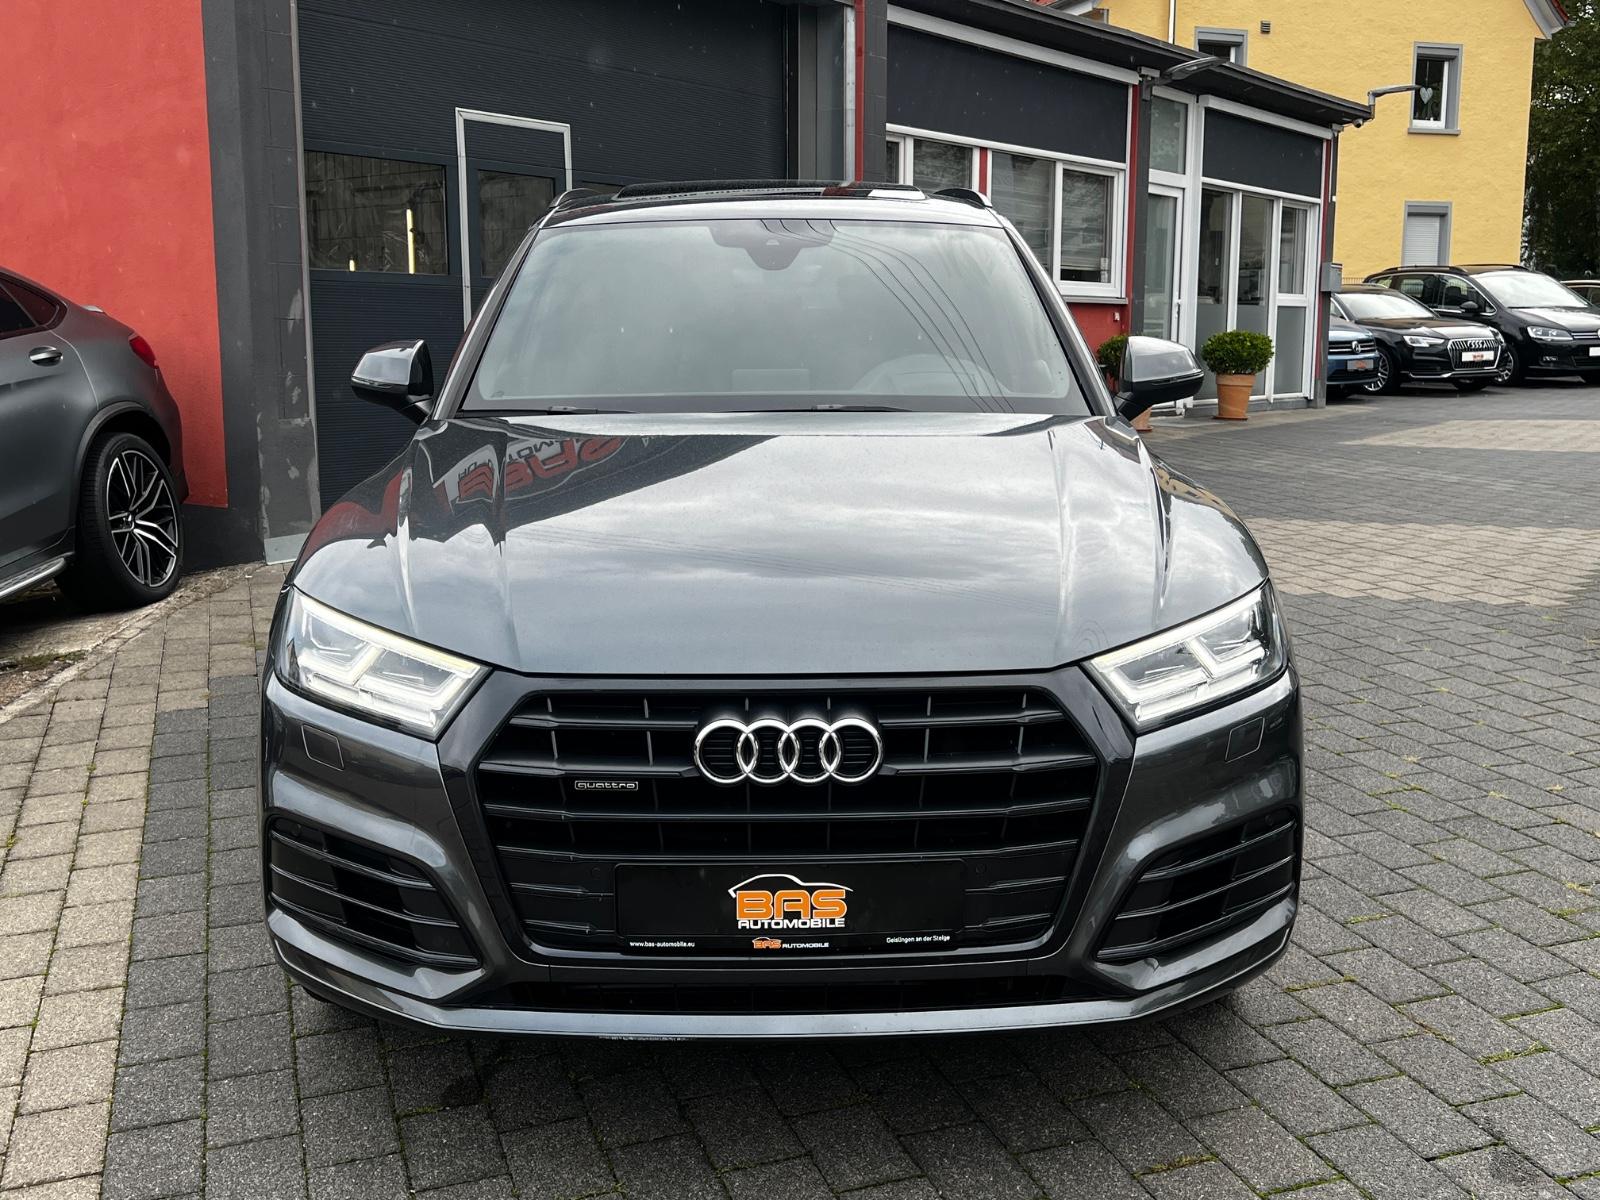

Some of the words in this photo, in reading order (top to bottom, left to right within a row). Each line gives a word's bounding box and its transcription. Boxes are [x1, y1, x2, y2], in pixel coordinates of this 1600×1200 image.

[736, 889, 847, 920] BAS
[738, 918, 845, 929] AUTOMOBILE
[753, 939, 781, 949] BAS
[886, 936, 915, 944] Geislingen
[932, 934, 950, 942] Steige
